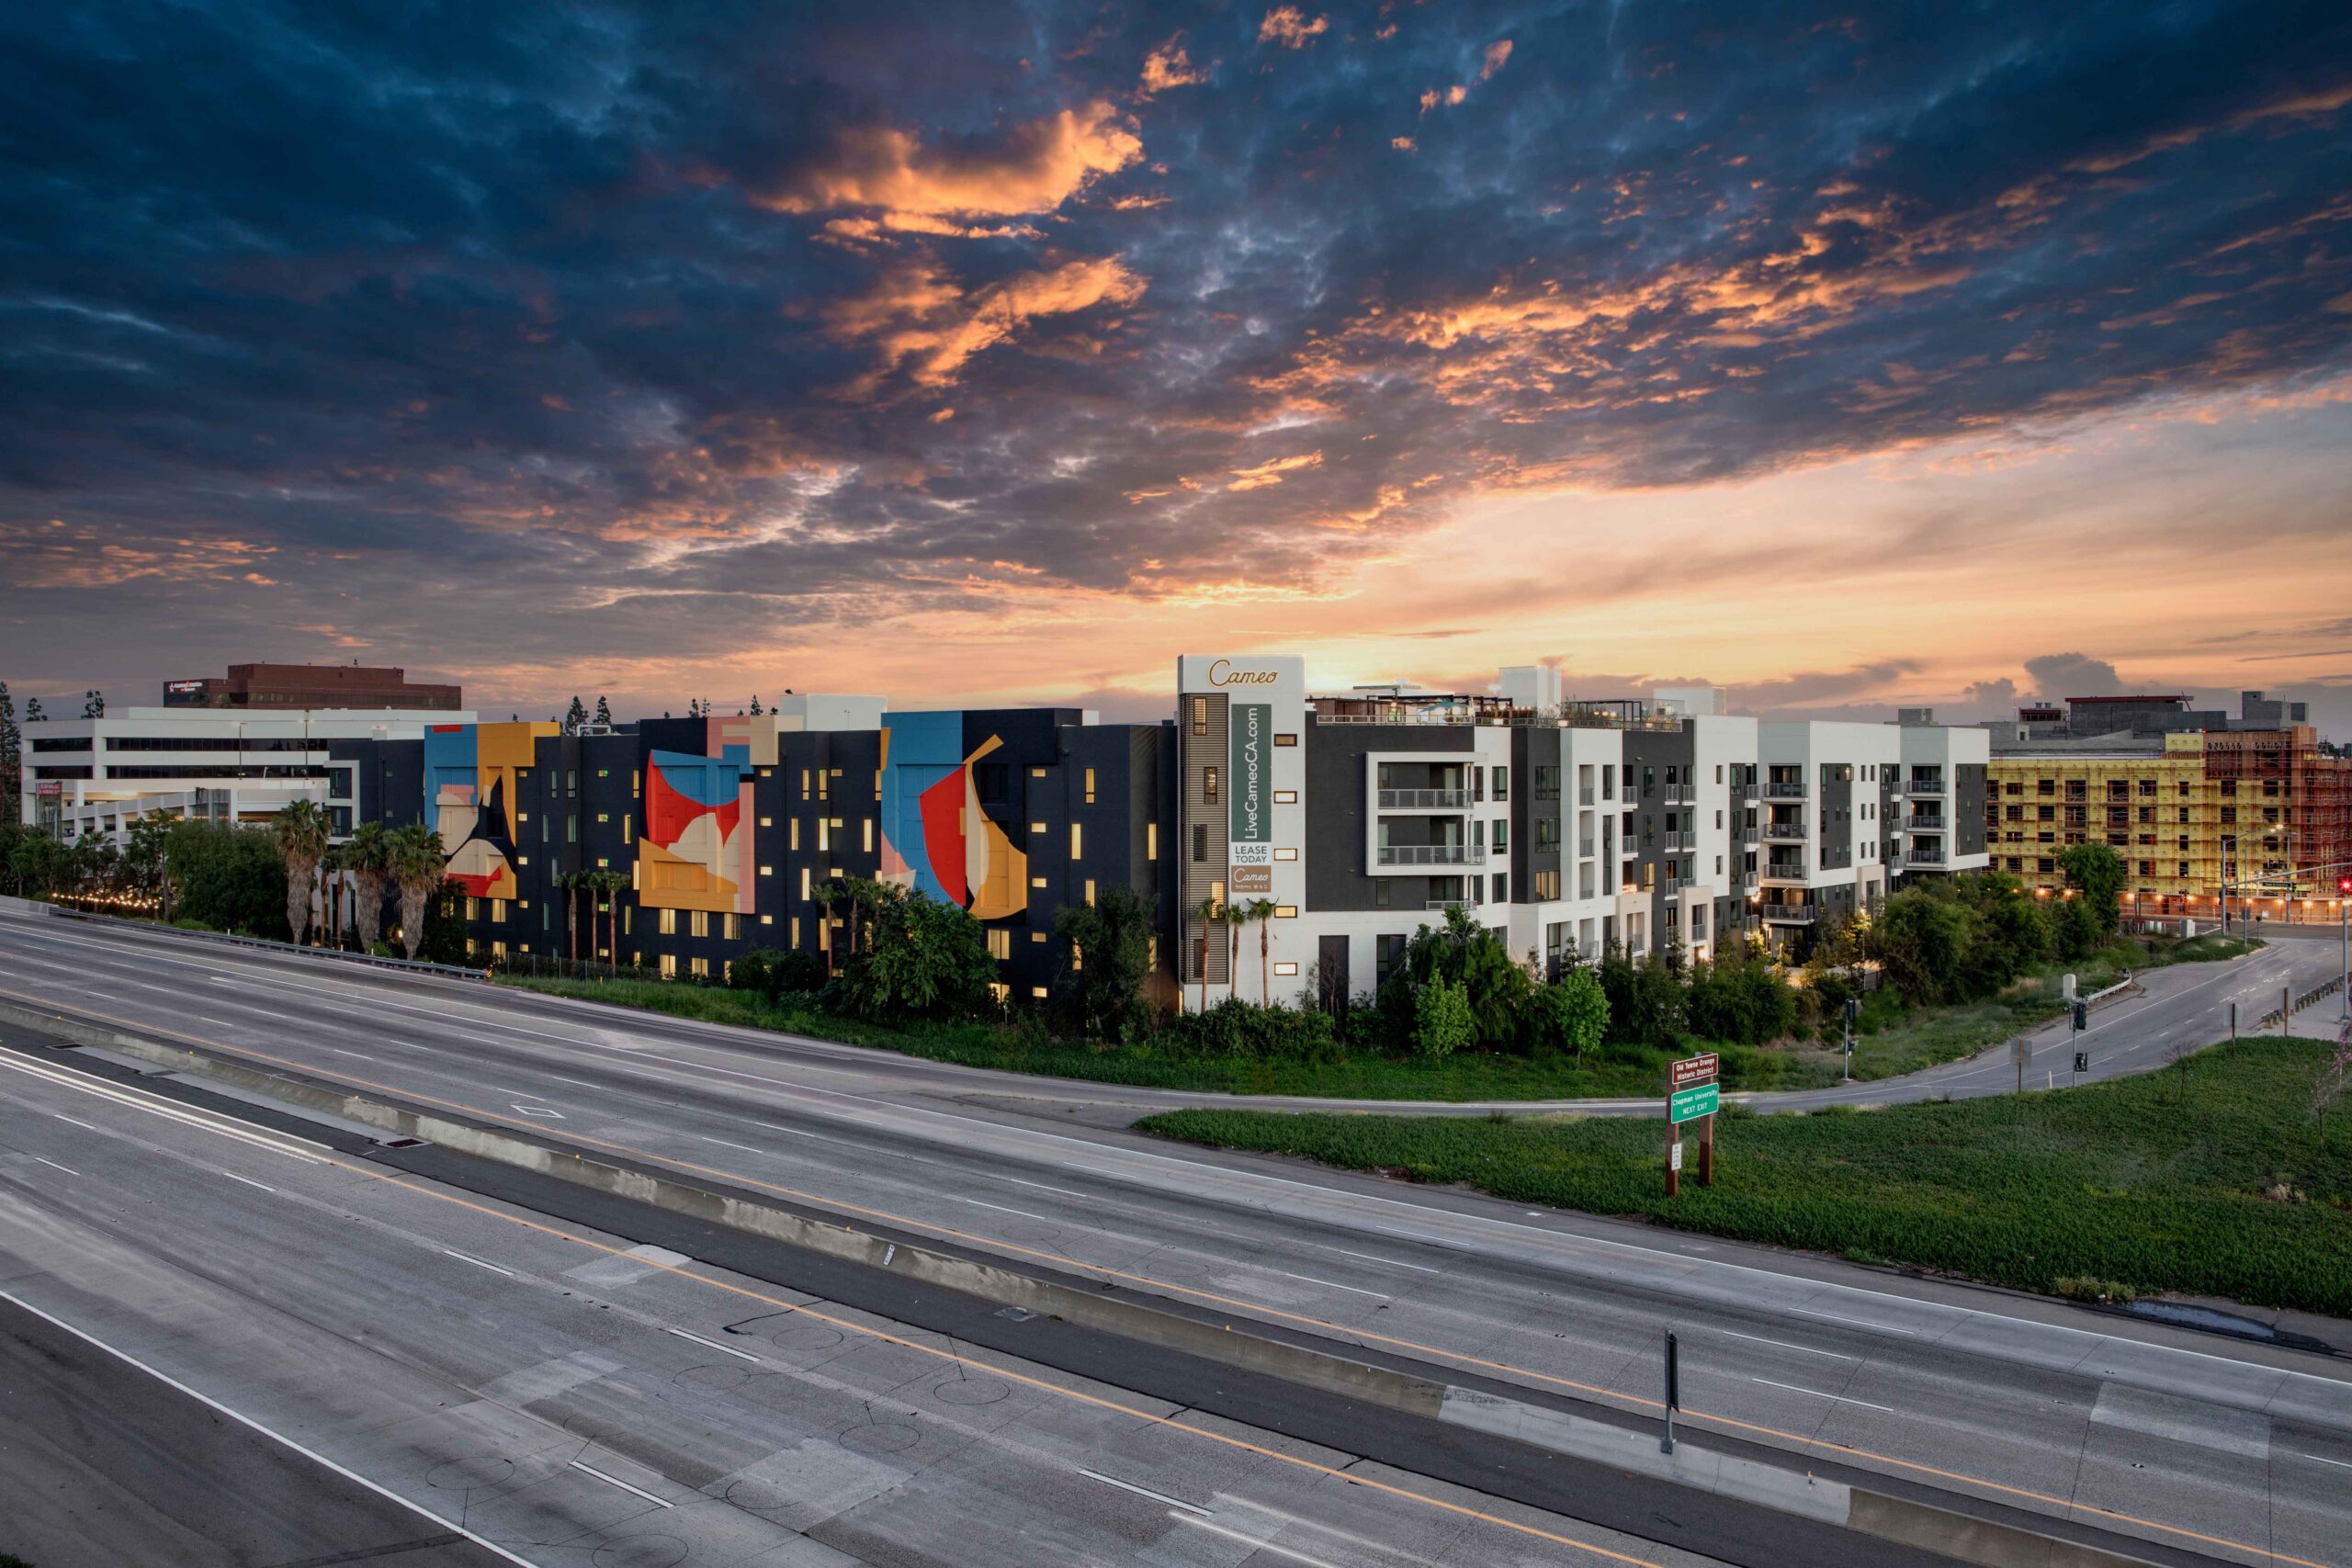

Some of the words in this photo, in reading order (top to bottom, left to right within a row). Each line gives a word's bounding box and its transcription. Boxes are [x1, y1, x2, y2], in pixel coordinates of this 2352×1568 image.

[1209, 659, 1278, 686] Cameo
[1245, 707, 1258, 839] LiveCameoCA.com
[1235, 846, 1267, 854] LEASE
[1235, 855, 1267, 863] TODAY
[1234, 867, 1268, 883] Cameo
[1677, 1072, 1696, 1081] Historic
[1697, 1067, 1714, 1076] District
[1673, 1096, 1693, 1106] Chapman
[1695, 1090, 1717, 1100] University
[1683, 1106, 1695, 1114] NEXT
[1697, 1102, 1707, 1111] EXIT
